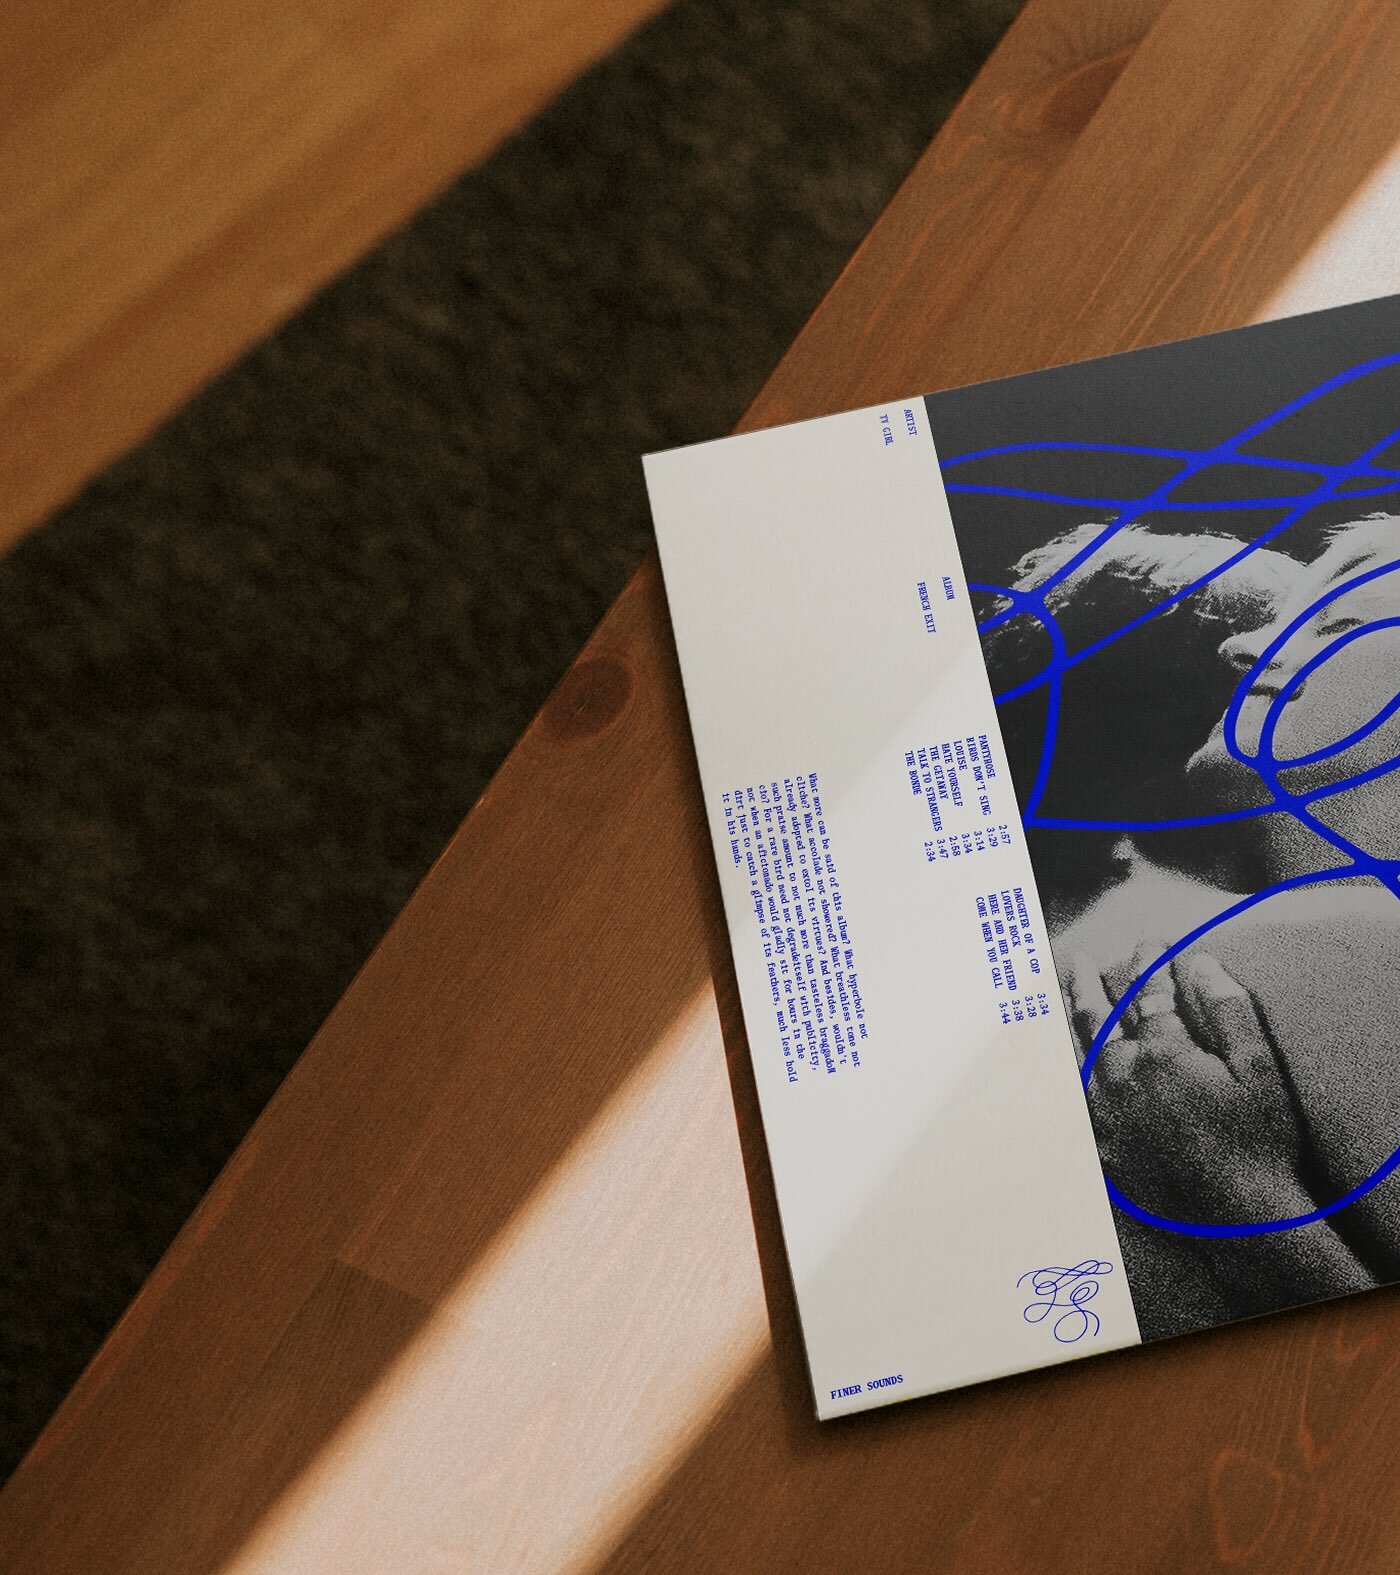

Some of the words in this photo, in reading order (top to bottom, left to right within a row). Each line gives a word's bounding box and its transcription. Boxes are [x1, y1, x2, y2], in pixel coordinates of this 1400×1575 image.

[880, 414, 889, 424] TV
[904, 409, 917, 435] ARTIST
[883, 427, 894, 445] GIRL
[942, 576, 955, 601] ALBUM
[917, 582, 931, 611] FRENCH
[924, 613, 937, 633] EXIT
[917, 748, 929, 769] TALK
[929, 746, 940, 762] THE
[941, 742, 954, 764] HATE
[966, 736, 979, 762] BIRDS
[808, 772, 819, 793] What
[921, 771, 933, 784] TO
[933, 764, 949, 799] GETAWAY
[947, 767, 963, 807] YOURSELF
[973, 765, 986, 791] DON'T
[722, 793, 730, 802] it
[734, 790, 744, 809] dirt
[746, 787, 755, 801] not
[759, 785, 771, 804] cio?
[771, 783, 781, 803] such
[783, 779, 796, 812] already
[953, 739, 968, 770] LOUISE
[973, 831, 985, 852] 3:14
[978, 734, 996, 779] PANTYHOSE
[997, 824, 1011, 845] 2:57
[725, 807, 733, 817] in
[750, 806, 759, 826] when
[763, 807, 773, 822] For
[813, 796, 822, 816] more
[905, 751, 916, 767] THE
[924, 841, 937, 862] 2:34
[925, 786, 943, 832] STRANGERS
[979, 795, 992, 816] SING
[727, 820, 736, 835] his
[737, 814, 749, 833] just
[773, 805, 787, 834] praise
[803, 813, 814, 832] What
[818, 821, 827, 836] can
[743, 837, 751, 847] to
[754, 830, 762, 840] an
[791, 816, 807, 851] adopted
[821, 837, 830, 850] be
[961, 833, 973, 855] 3:34
[986, 827, 999, 848] 3:29
[730, 839, 742, 868] hands.
[768, 836, 779, 856] rare
[782, 838, 793, 868] amount
[808, 837, 824, 876] accolade
[937, 839, 949, 859] 3:47
[947, 835, 961, 857] 2:58
[745, 851, 758, 876] catch
[773, 859, 785, 881] bird
[799, 854, 807, 865] to
[825, 854, 837, 874] said
[751, 879, 757, 887] a
[789, 872, 797, 883] to
[801, 868, 815, 893] extol
[816, 879, 826, 896] not
[829, 876, 840, 888] of
[778, 883, 790, 905] need
[790, 885, 801, 901] not
[832, 891, 843, 912] this
[751, 889, 765, 924] glimpse
[767, 896, 781, 922] would
[782, 907, 792, 924] not
[794, 904, 807, 926] much
[807, 897, 816, 913] its
[975, 896, 988, 918] COME
[988, 893, 1000, 916] HERE
[820, 898, 838, 943] showered?
[837, 915, 851, 945] album?
[993, 919, 1005, 935] AND
[760, 927, 770, 939] of
[771, 925, 786, 955] gladly
[799, 928, 810, 949] more
[811, 916, 827, 955] virtues?
[980, 921, 994, 943] WHEN
[763, 942, 773, 958] its
[829, 945, 841, 967] What
[986, 947, 998, 963] YOU
[997, 939, 1009, 956] HER
[1001, 890, 1015, 922] LOVERS
[1008, 924, 1021, 947] ROCK
[1025, 997, 1037, 1019] 3:28
[1014, 887, 1030, 929] DAUGHTER
[1023, 932, 1034, 945] OF
[1029, 957, 1041, 974] COP
[1037, 993, 1049, 1016] 3:34
[779, 959, 789, 975] sit
[804, 953, 815, 975] than
[819, 959, 831, 976] And
[843, 948, 855, 970] What
[783, 978, 793, 994] for
[991, 966, 1003, 988] CALL
[1003, 959, 1017, 991] FRIEND
[799, 995, 811, 1017] with
[809, 978, 824, 1024] tasteless
[836, 970, 850, 1022] breathless
[847, 973, 864, 1020] hyperbole
[776, 1010, 789, 1033] much
[786, 997, 798, 1024] hours
[998, 1002, 1012, 1024] 3:44
[1011, 1000, 1024, 1022] 3:38
[793, 1028, 802, 1040] in
[845, 1025, 857, 1047] tone
[858, 1023, 868, 1039] not
[781, 1036, 791, 1057] less
[795, 1043, 806, 1060] the
[850, 1050, 860, 1068] not
[786, 1060, 798, 1083] hold
[830, 1384, 862, 1400] FINER
[867, 1374, 904, 1391] SOUNDS
